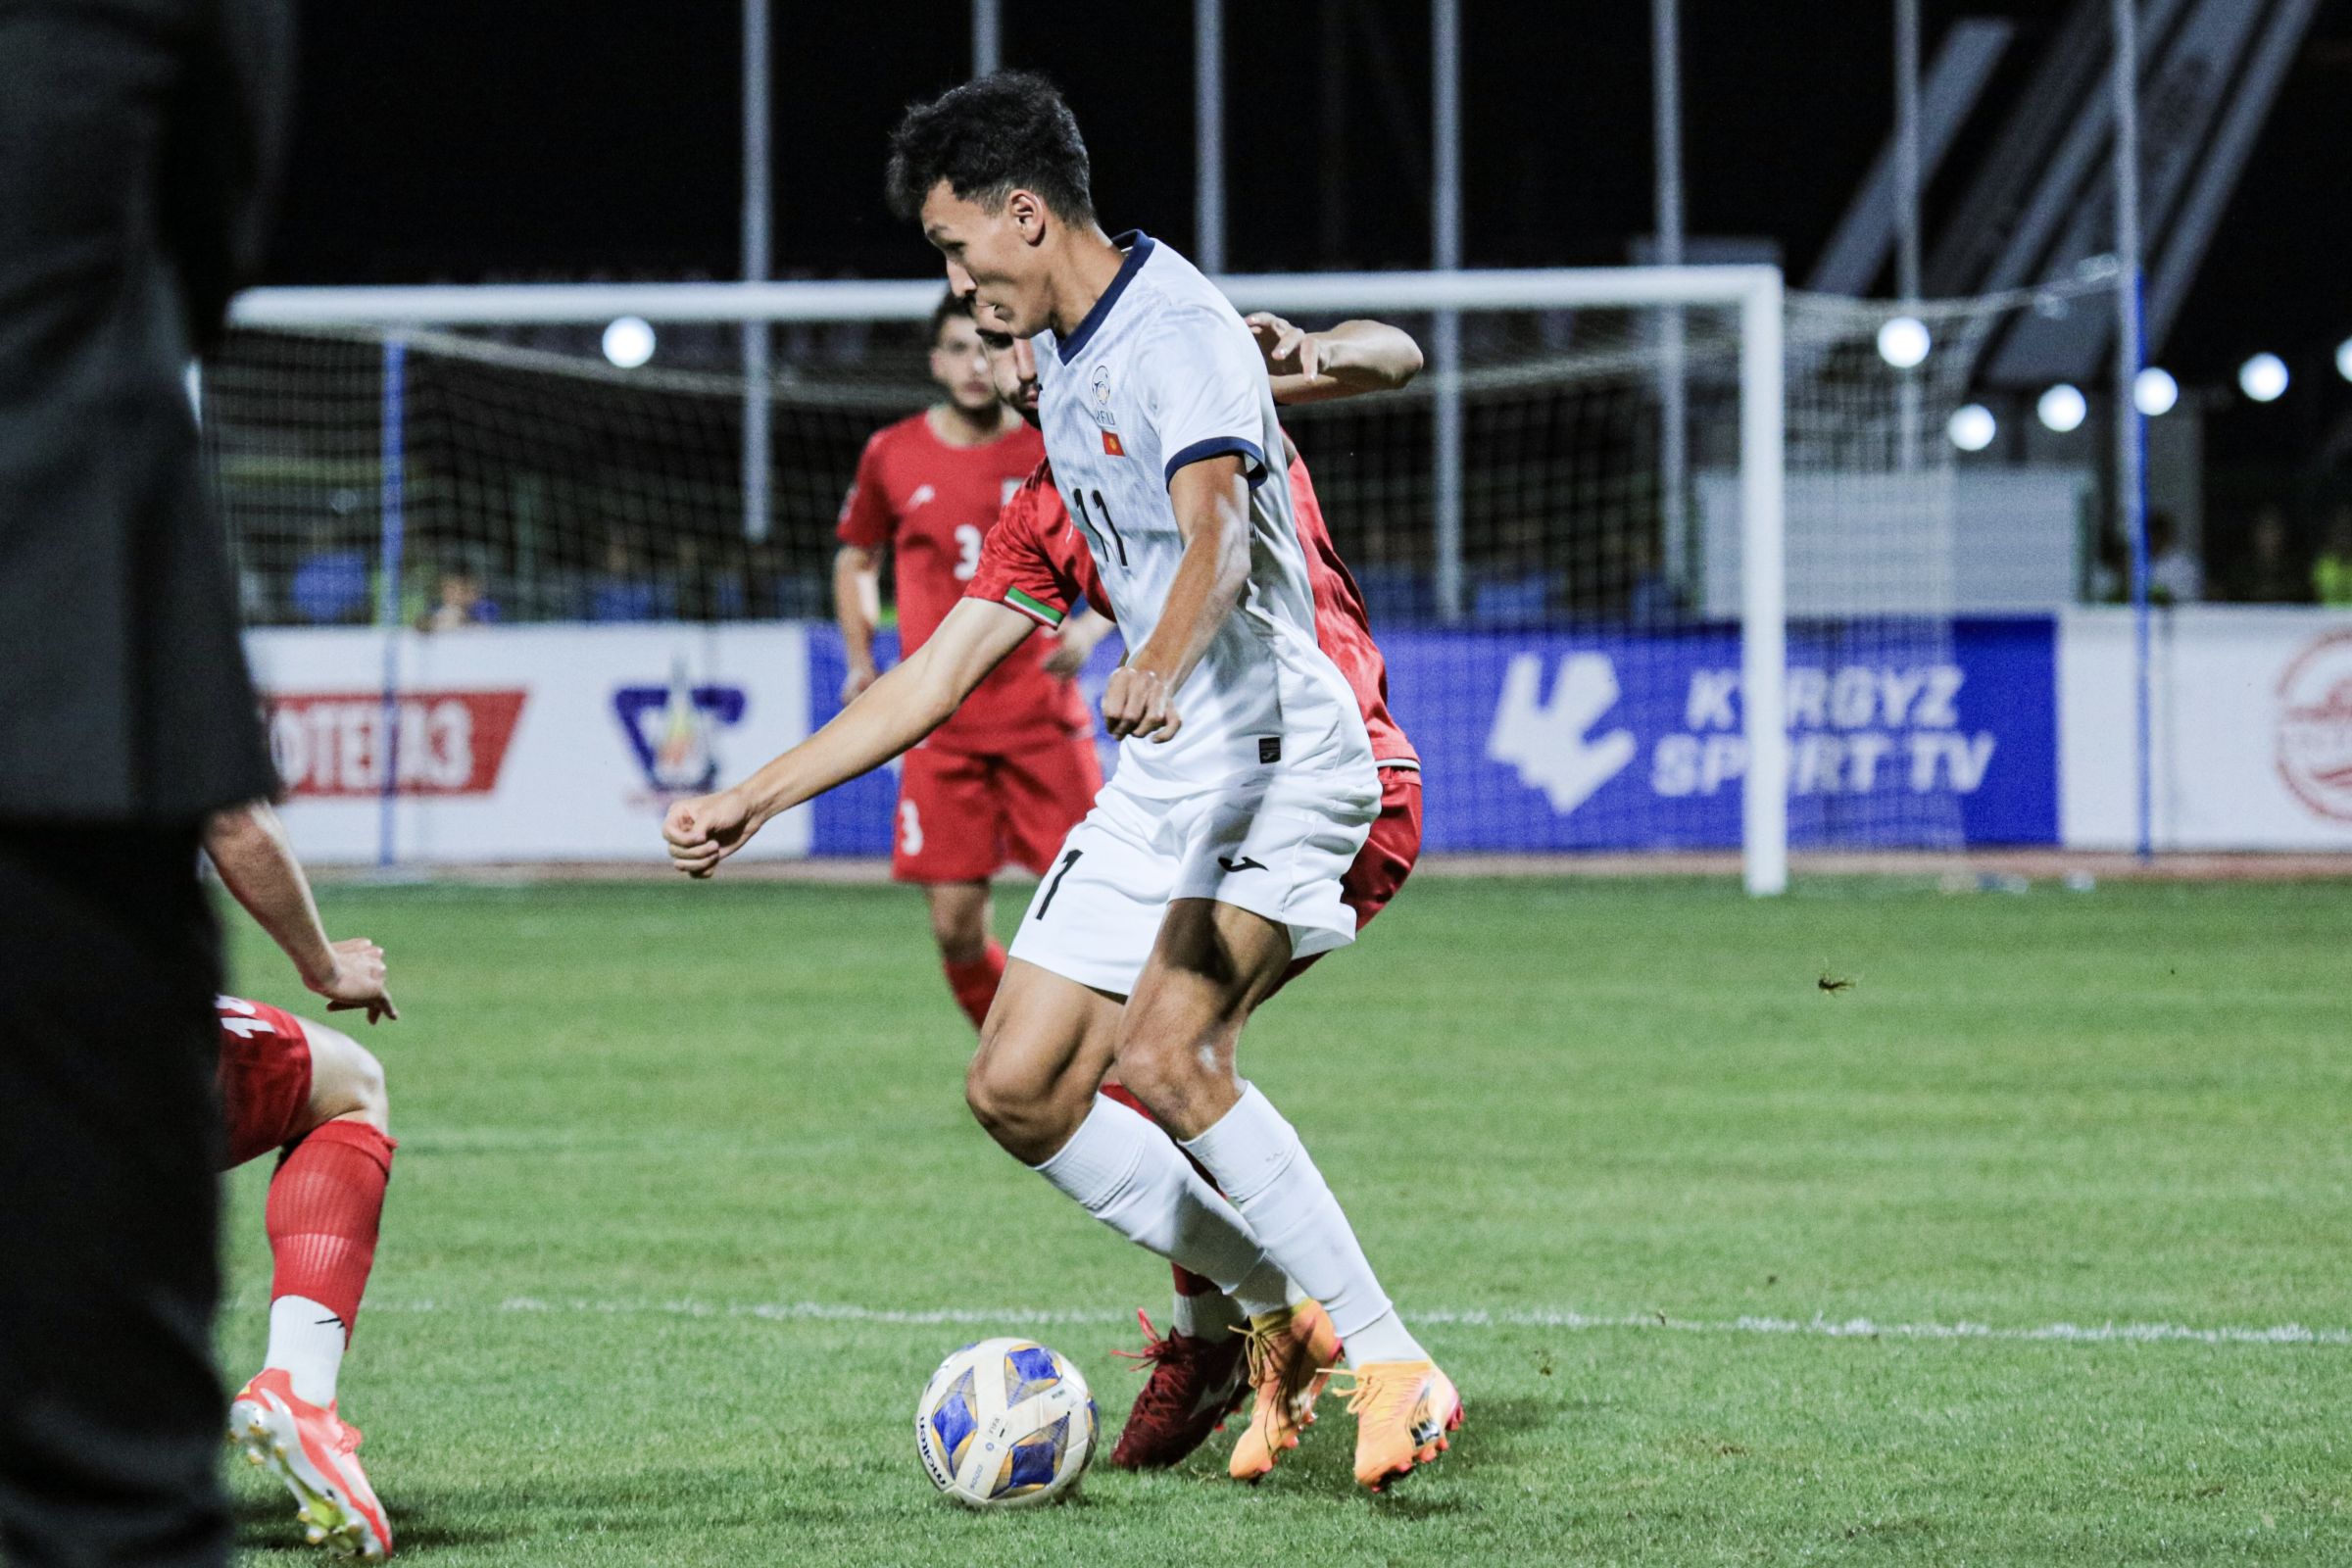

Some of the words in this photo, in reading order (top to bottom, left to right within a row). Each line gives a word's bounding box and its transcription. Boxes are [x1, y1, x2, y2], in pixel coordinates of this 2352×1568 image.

[954, 523, 981, 581] 3
[1073, 488, 1128, 566] 11
[1686, 665, 1964, 730] KRGYZ
[1651, 732, 1889, 796] SPRT
[1910, 729, 1997, 794] TV
[1036, 849, 1084, 920] 1
[919, 1416, 946, 1486] molten
